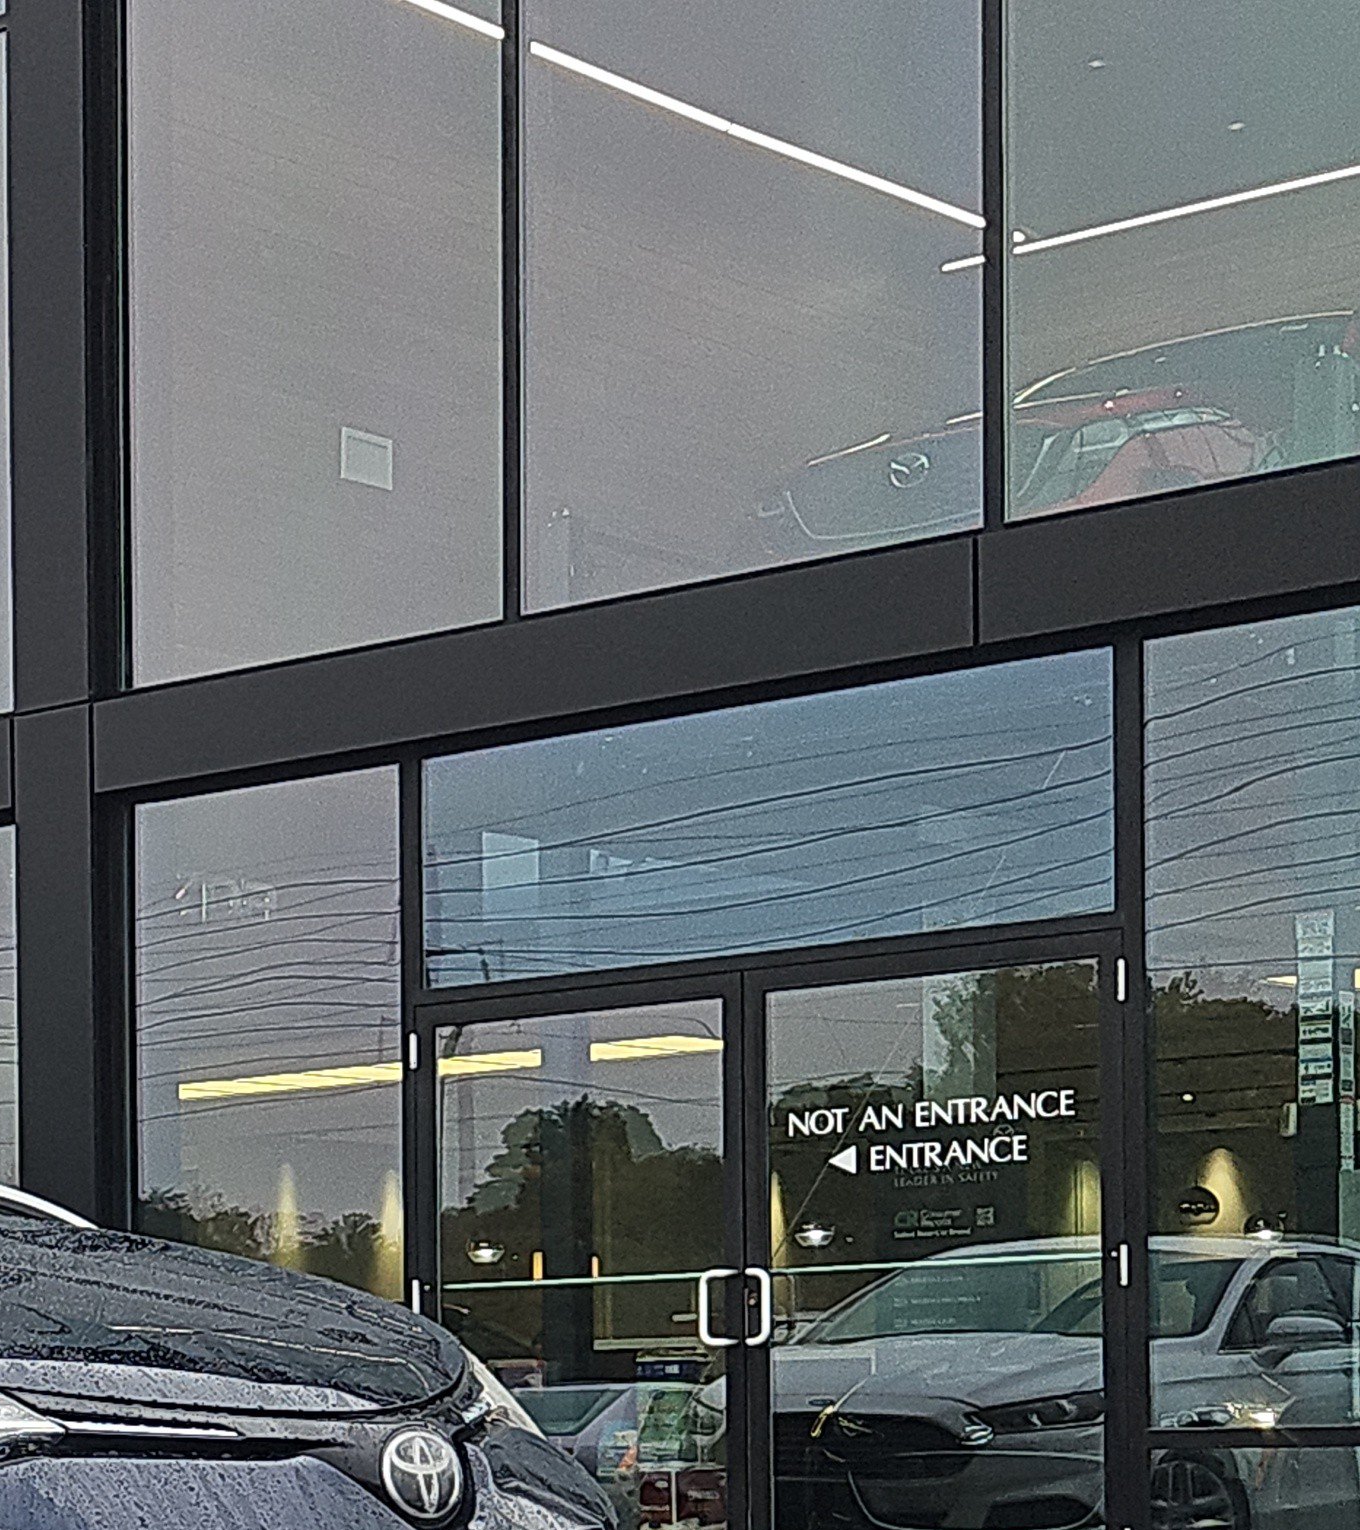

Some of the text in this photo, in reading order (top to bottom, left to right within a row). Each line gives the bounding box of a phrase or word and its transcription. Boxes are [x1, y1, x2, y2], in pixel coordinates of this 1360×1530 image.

[787, 1089, 1076, 1138] NOT AN ENTRANCE
[869, 1134, 1029, 1172] ENTRANCE
